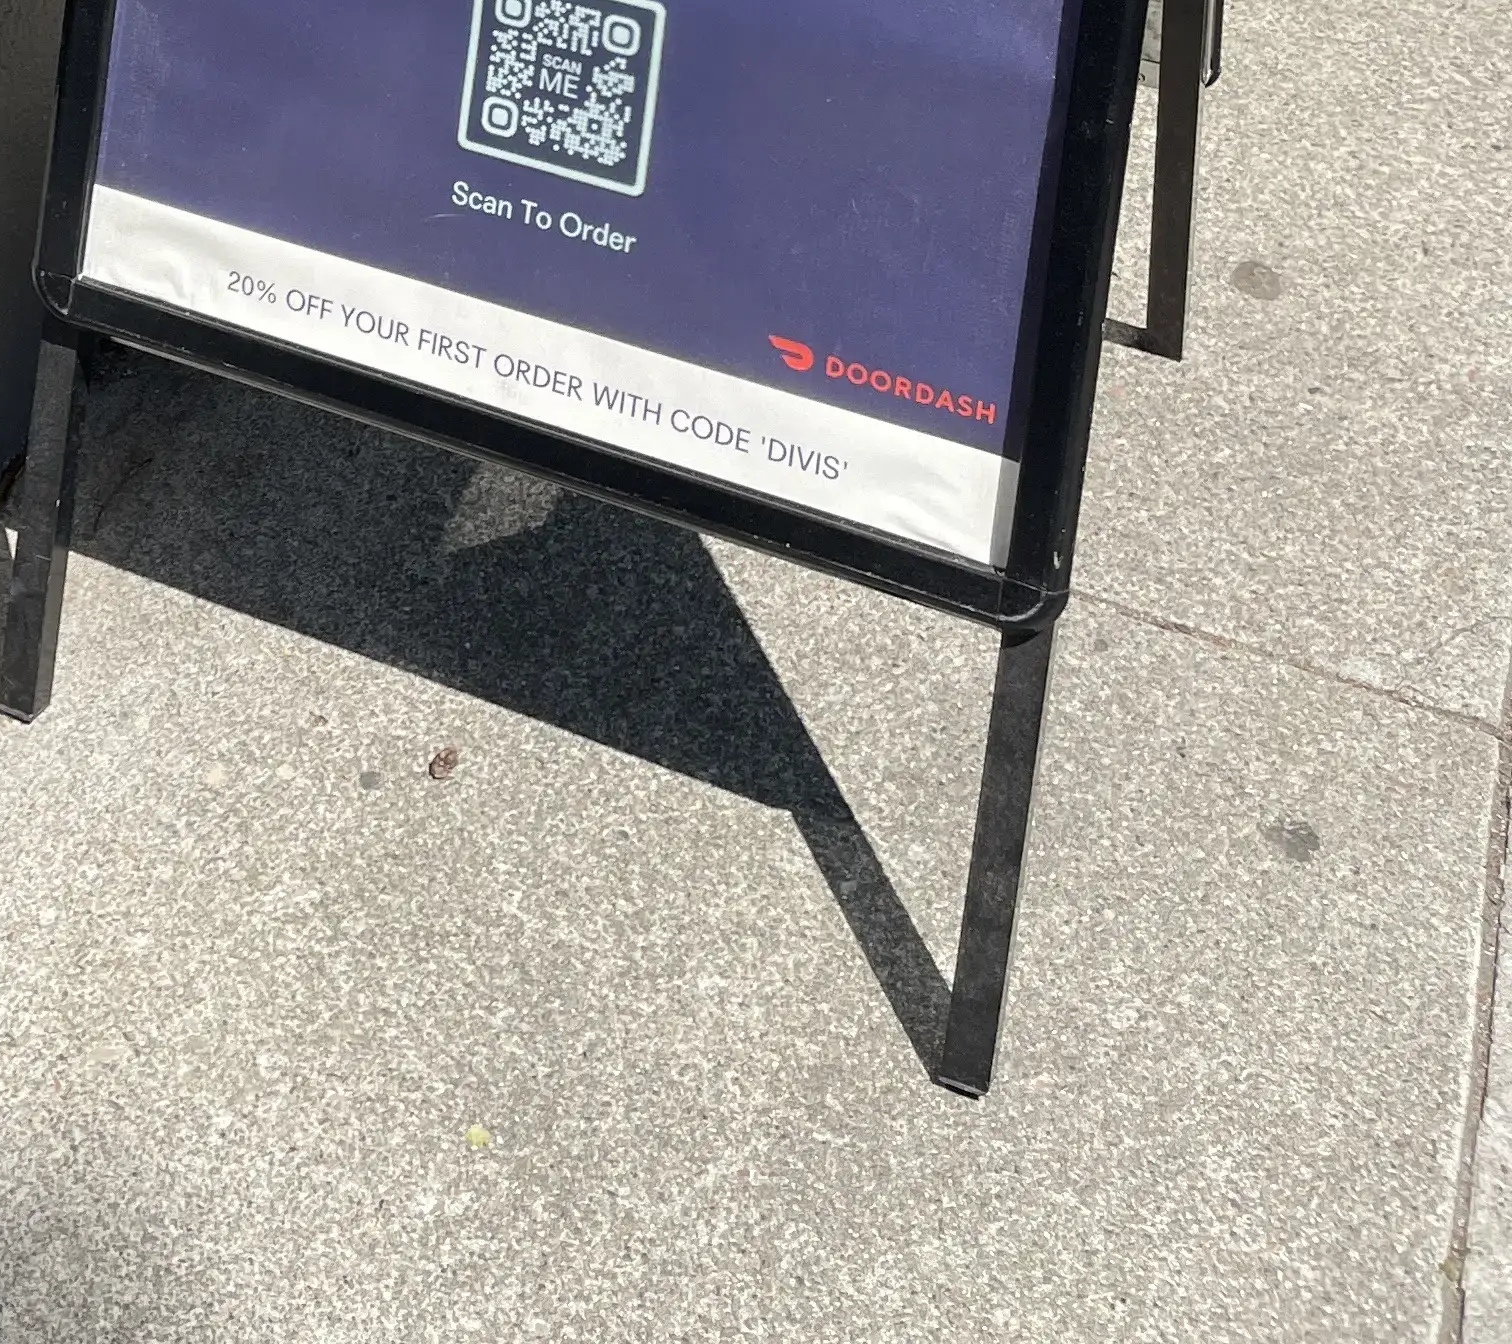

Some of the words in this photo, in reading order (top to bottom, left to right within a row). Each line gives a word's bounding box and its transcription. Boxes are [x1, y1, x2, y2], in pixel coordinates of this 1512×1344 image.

[539, 68, 581, 99] ME
[542, 53, 582, 75] SCAN
[451, 181, 514, 220] Scan
[521, 197, 555, 231] To
[559, 210, 637, 255] Order
[226, 270, 279, 305] 20%
[285, 287, 335, 322] OFF
[339, 303, 412, 346] YOUR
[416, 327, 489, 371] FIRST
[492, 351, 584, 403] ORDER
[590, 380, 664, 426] WITH
[669, 402, 751, 451] CODE
[757, 432, 850, 482] 'DIVIS'
[824, 354, 998, 426] DOORDASH
